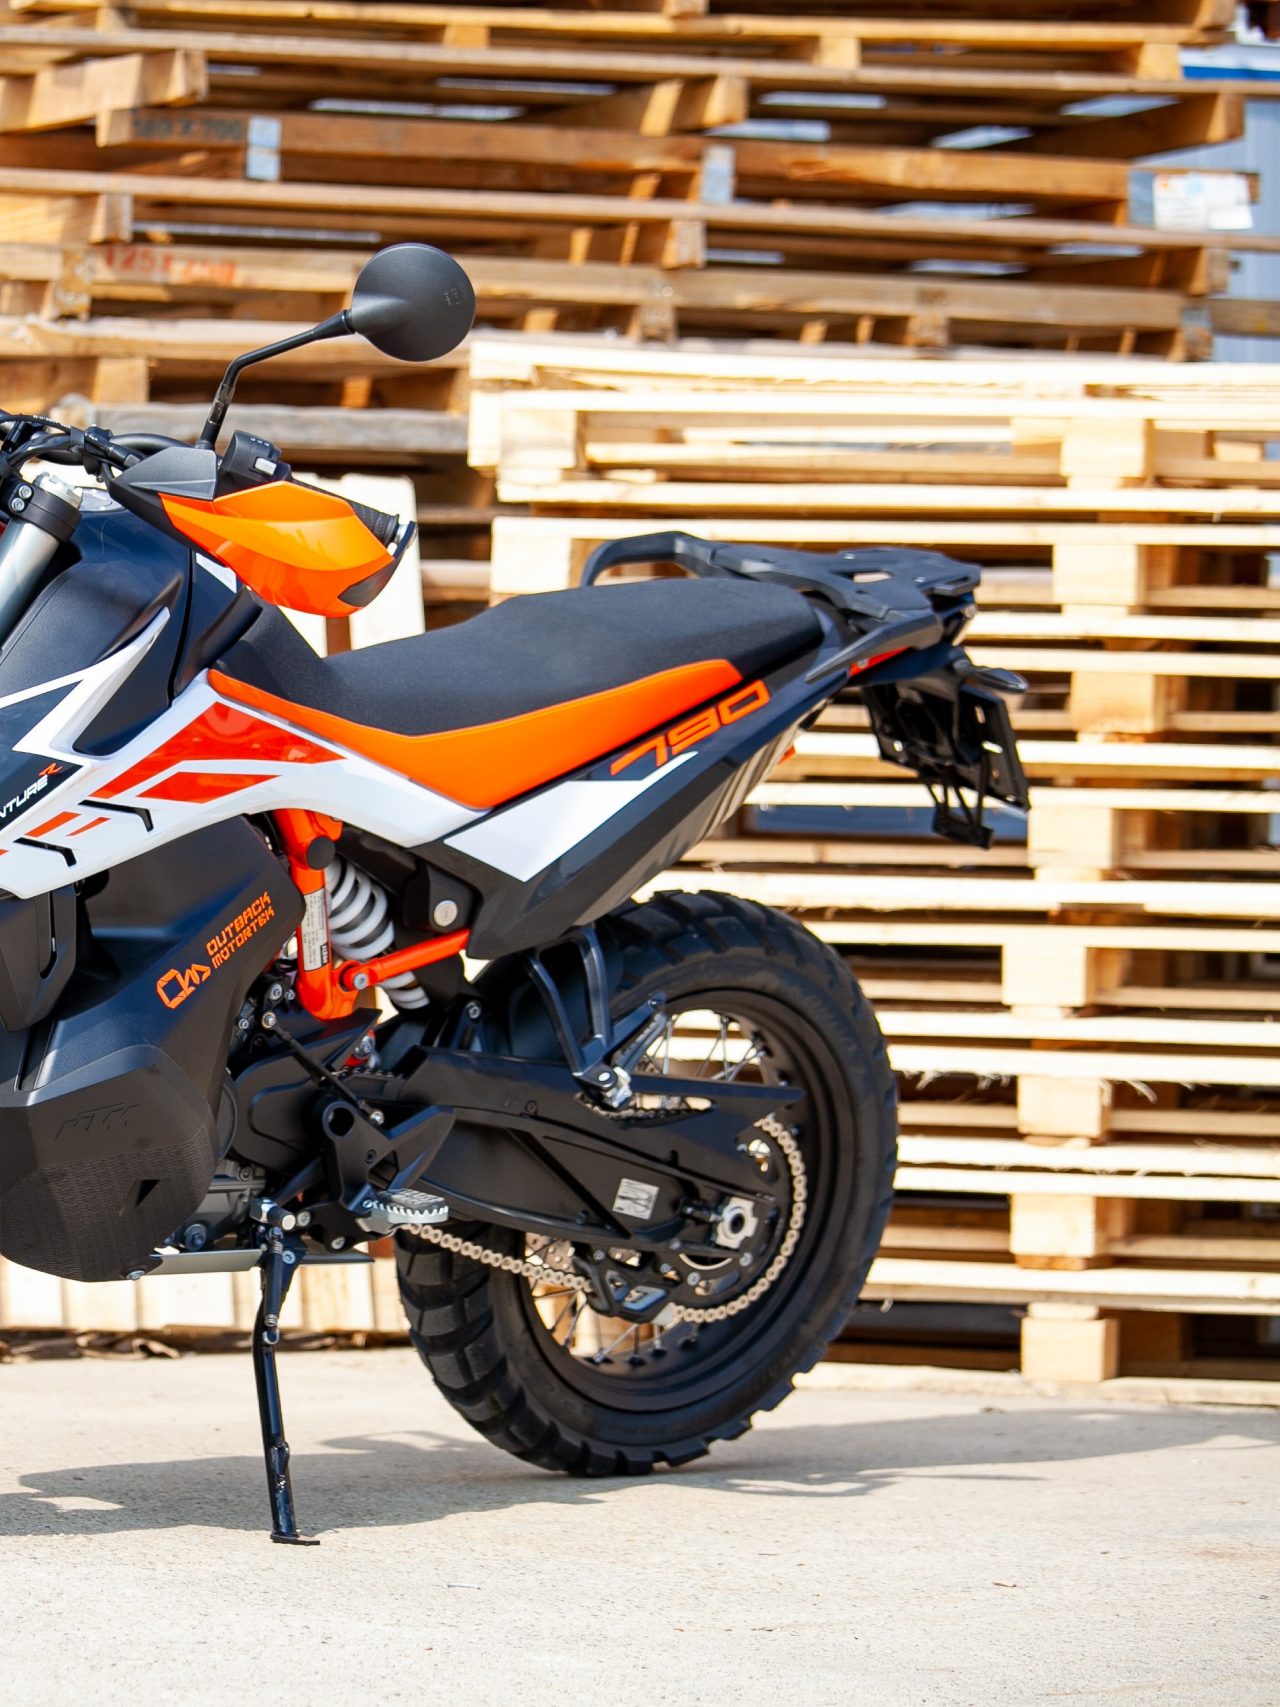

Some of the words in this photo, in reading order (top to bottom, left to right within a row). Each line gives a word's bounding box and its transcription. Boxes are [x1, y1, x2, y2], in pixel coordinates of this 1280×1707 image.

[610, 679, 770, 776] 790
[206, 891, 271, 956] OUTBACK
[211, 905, 275, 969] MOTORTEK
